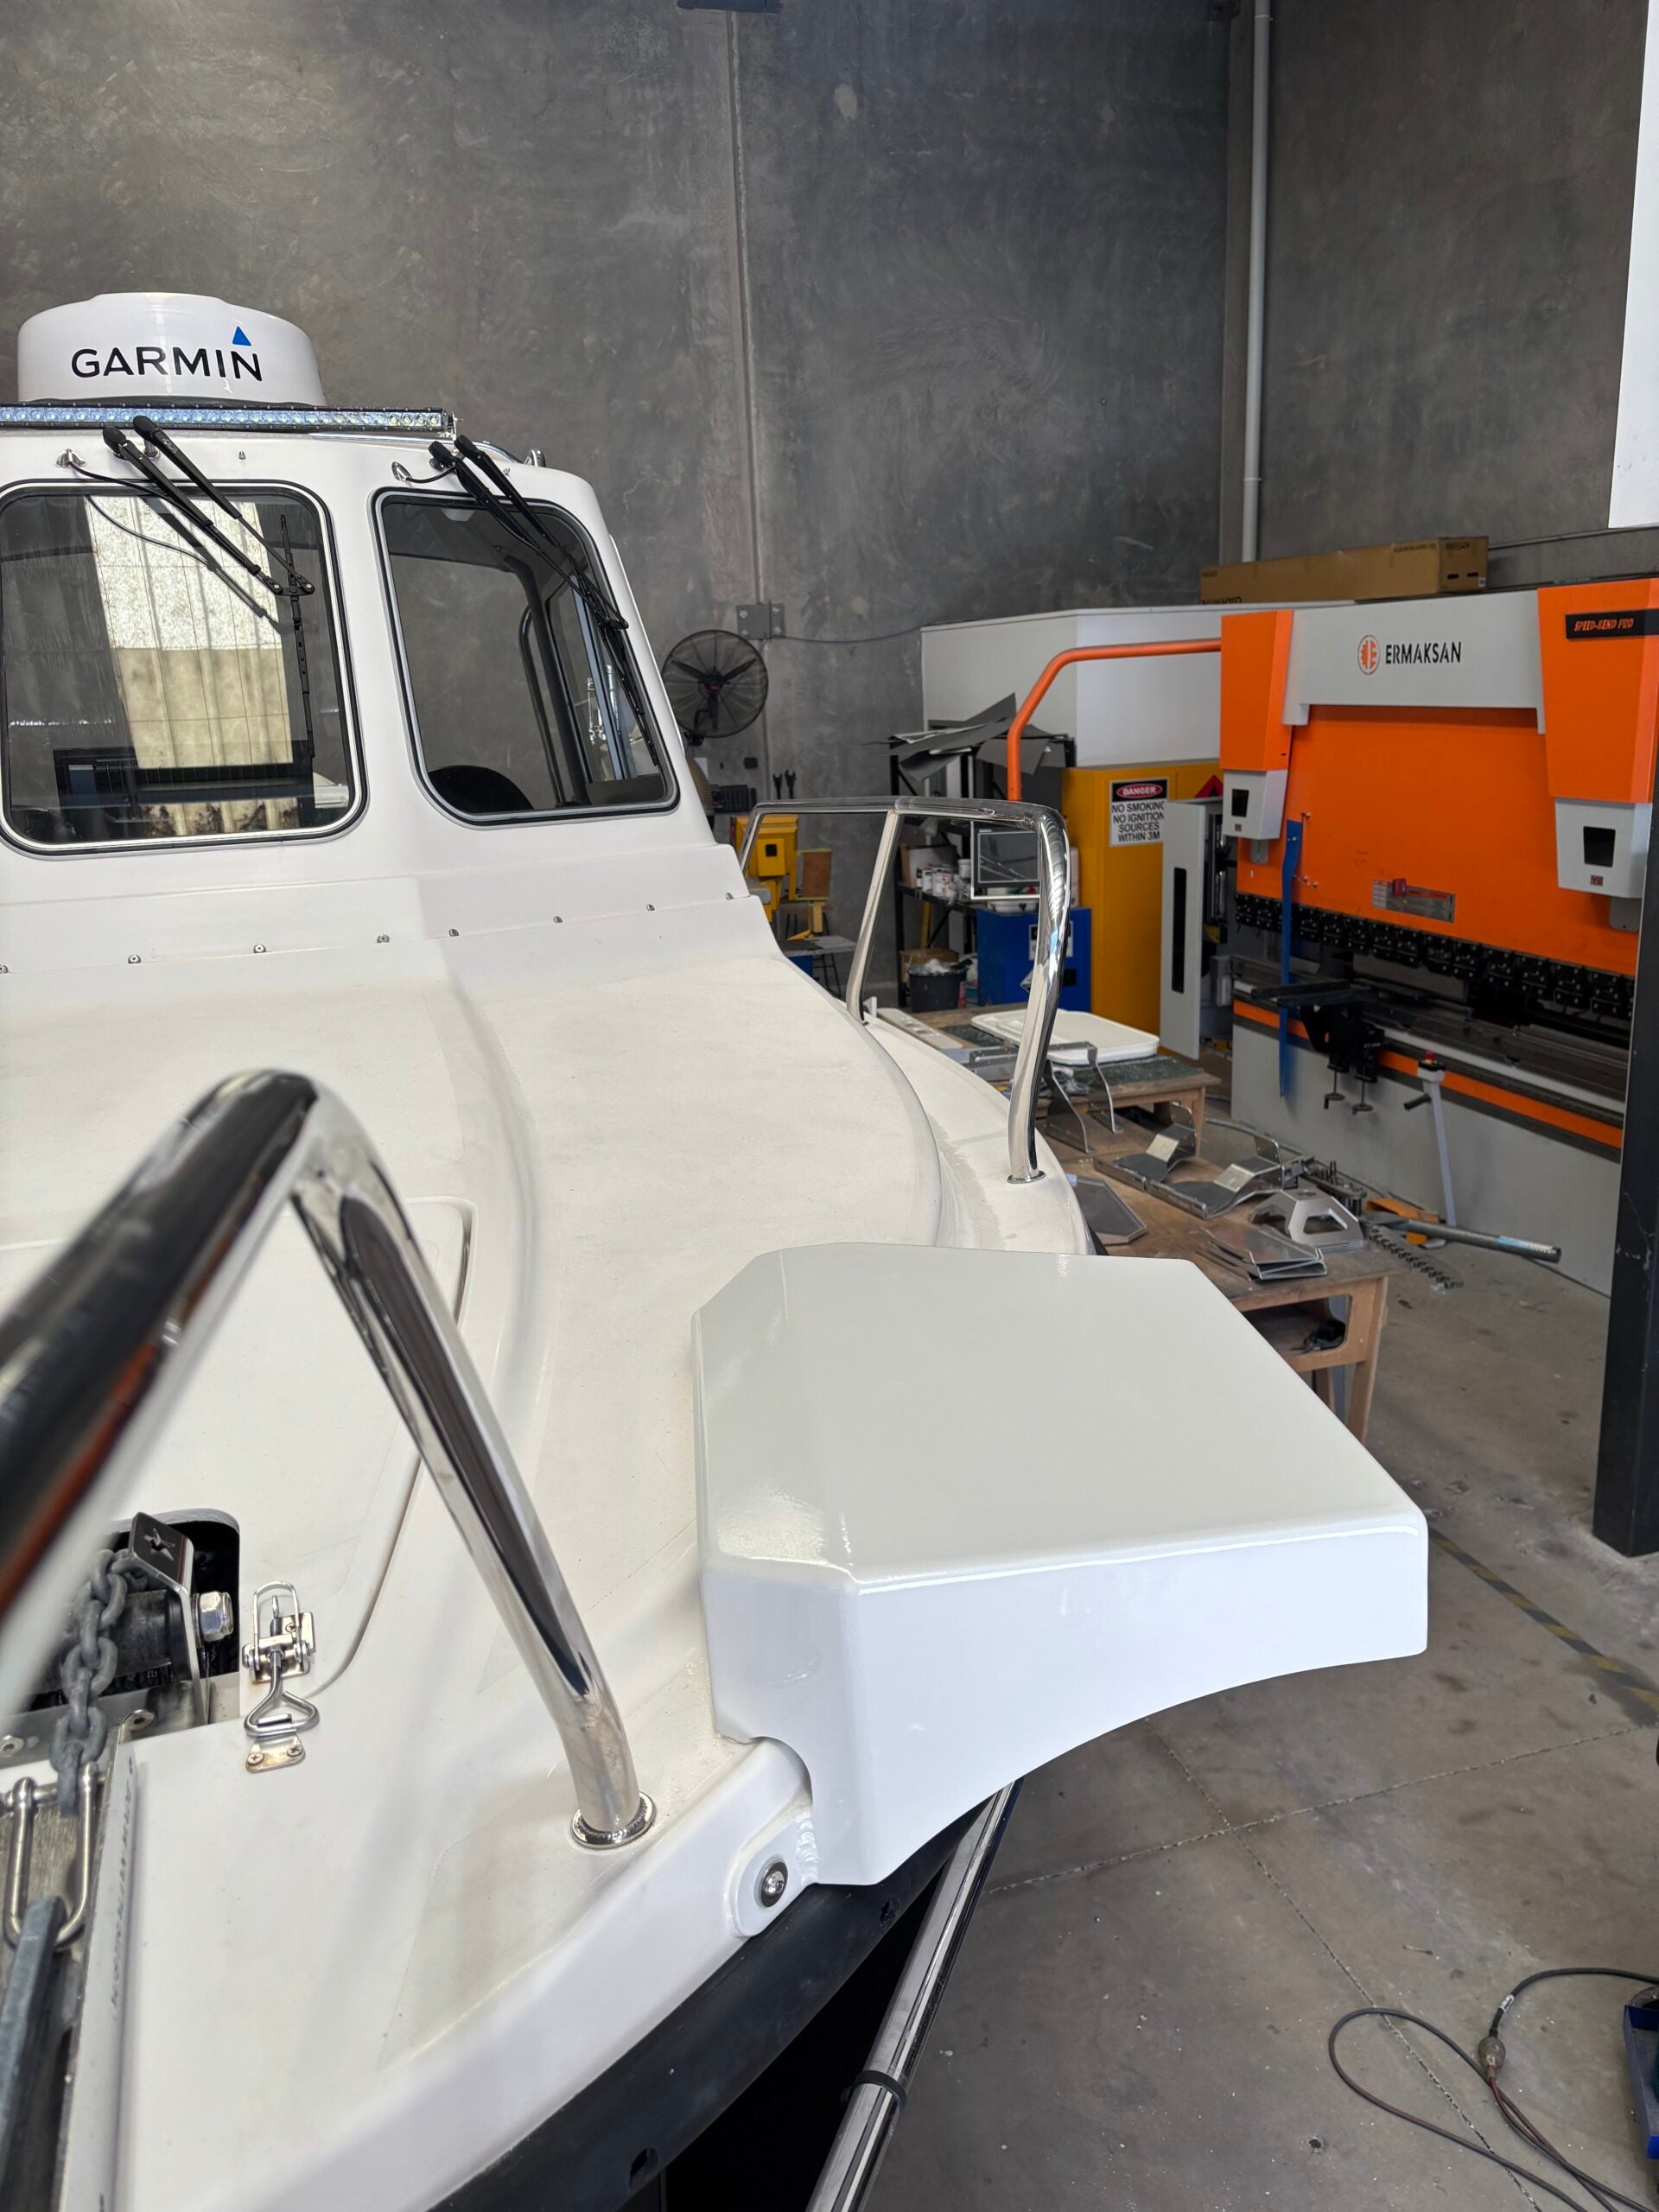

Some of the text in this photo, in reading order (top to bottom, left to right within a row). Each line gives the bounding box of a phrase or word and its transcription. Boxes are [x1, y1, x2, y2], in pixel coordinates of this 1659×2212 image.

[71, 346, 263, 382] GARMIN
[1385, 641, 1461, 664] ERMAKSAN
[1122, 786, 1156, 795] DANGER
[1112, 804, 1125, 813] NO
[1113, 815, 1126, 823] NO
[1119, 822, 1160, 832] SOURCES
[1118, 831, 1160, 842] WITHIN 3M
